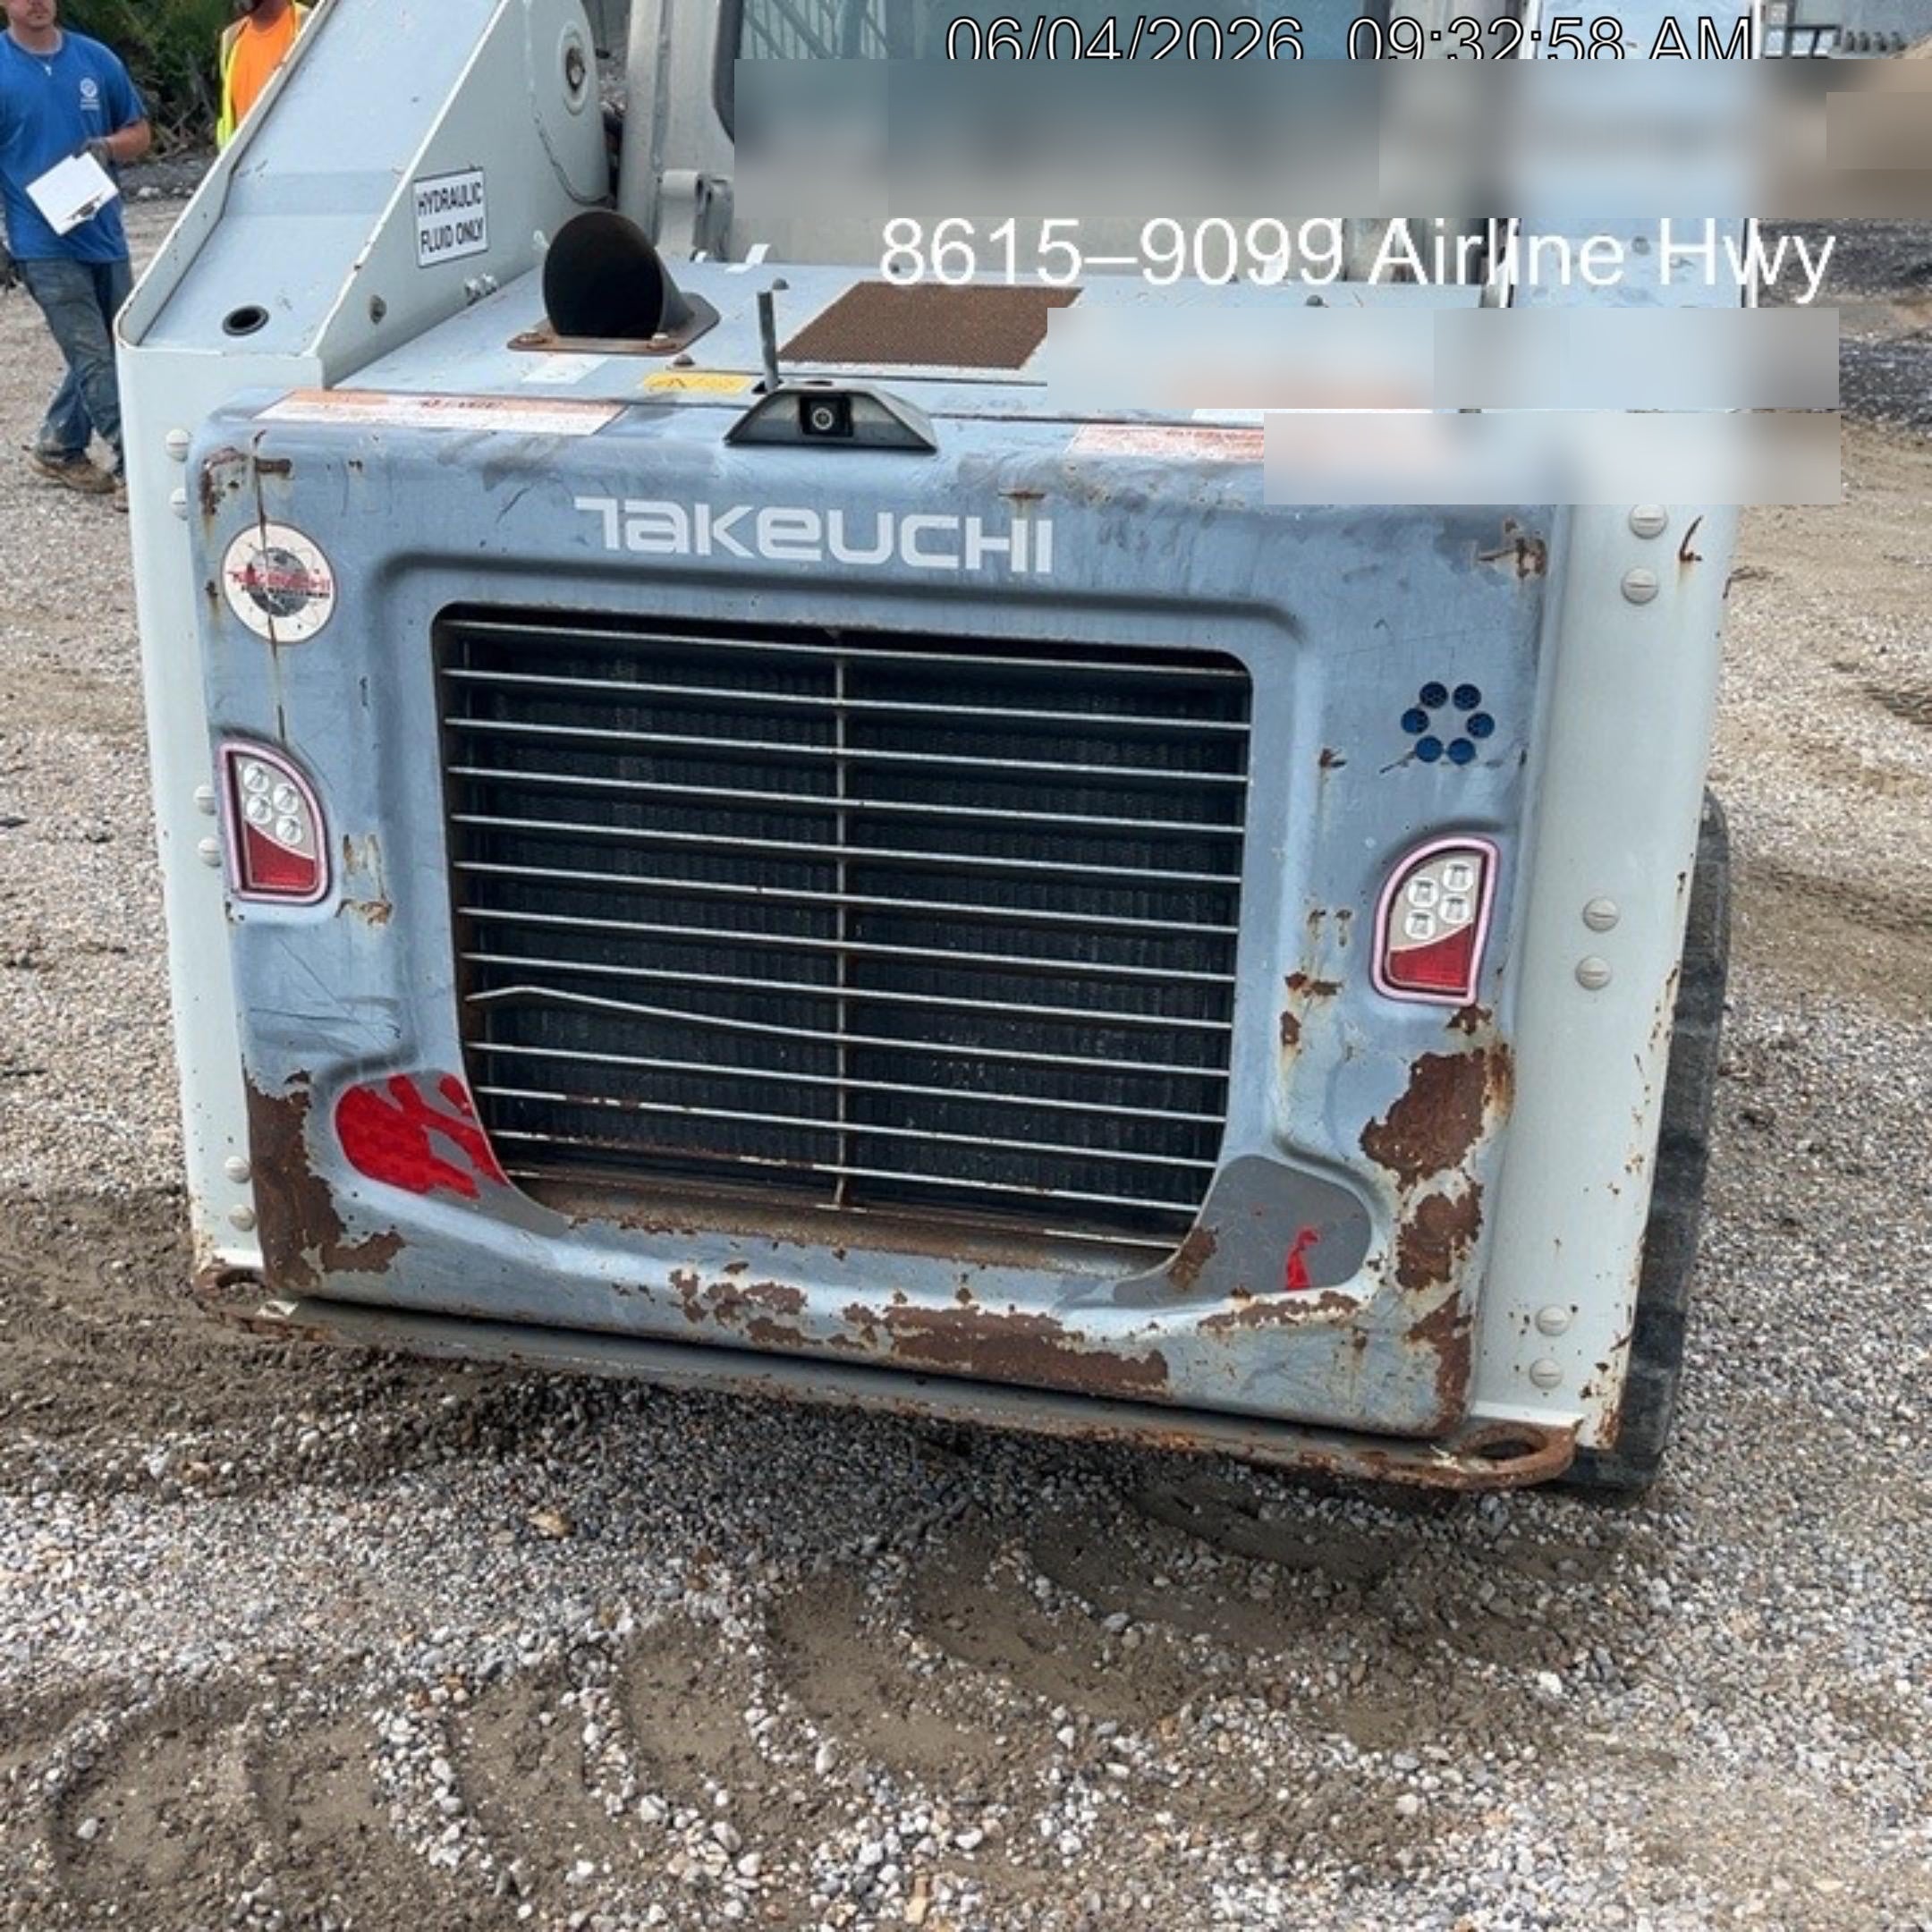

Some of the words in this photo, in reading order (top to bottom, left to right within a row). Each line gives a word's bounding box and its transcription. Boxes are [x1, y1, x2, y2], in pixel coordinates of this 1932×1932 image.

[417, 181, 482, 217] HYDRAULIC
[420, 224, 453, 256] FLUID
[455, 216, 484, 245] ONLY
